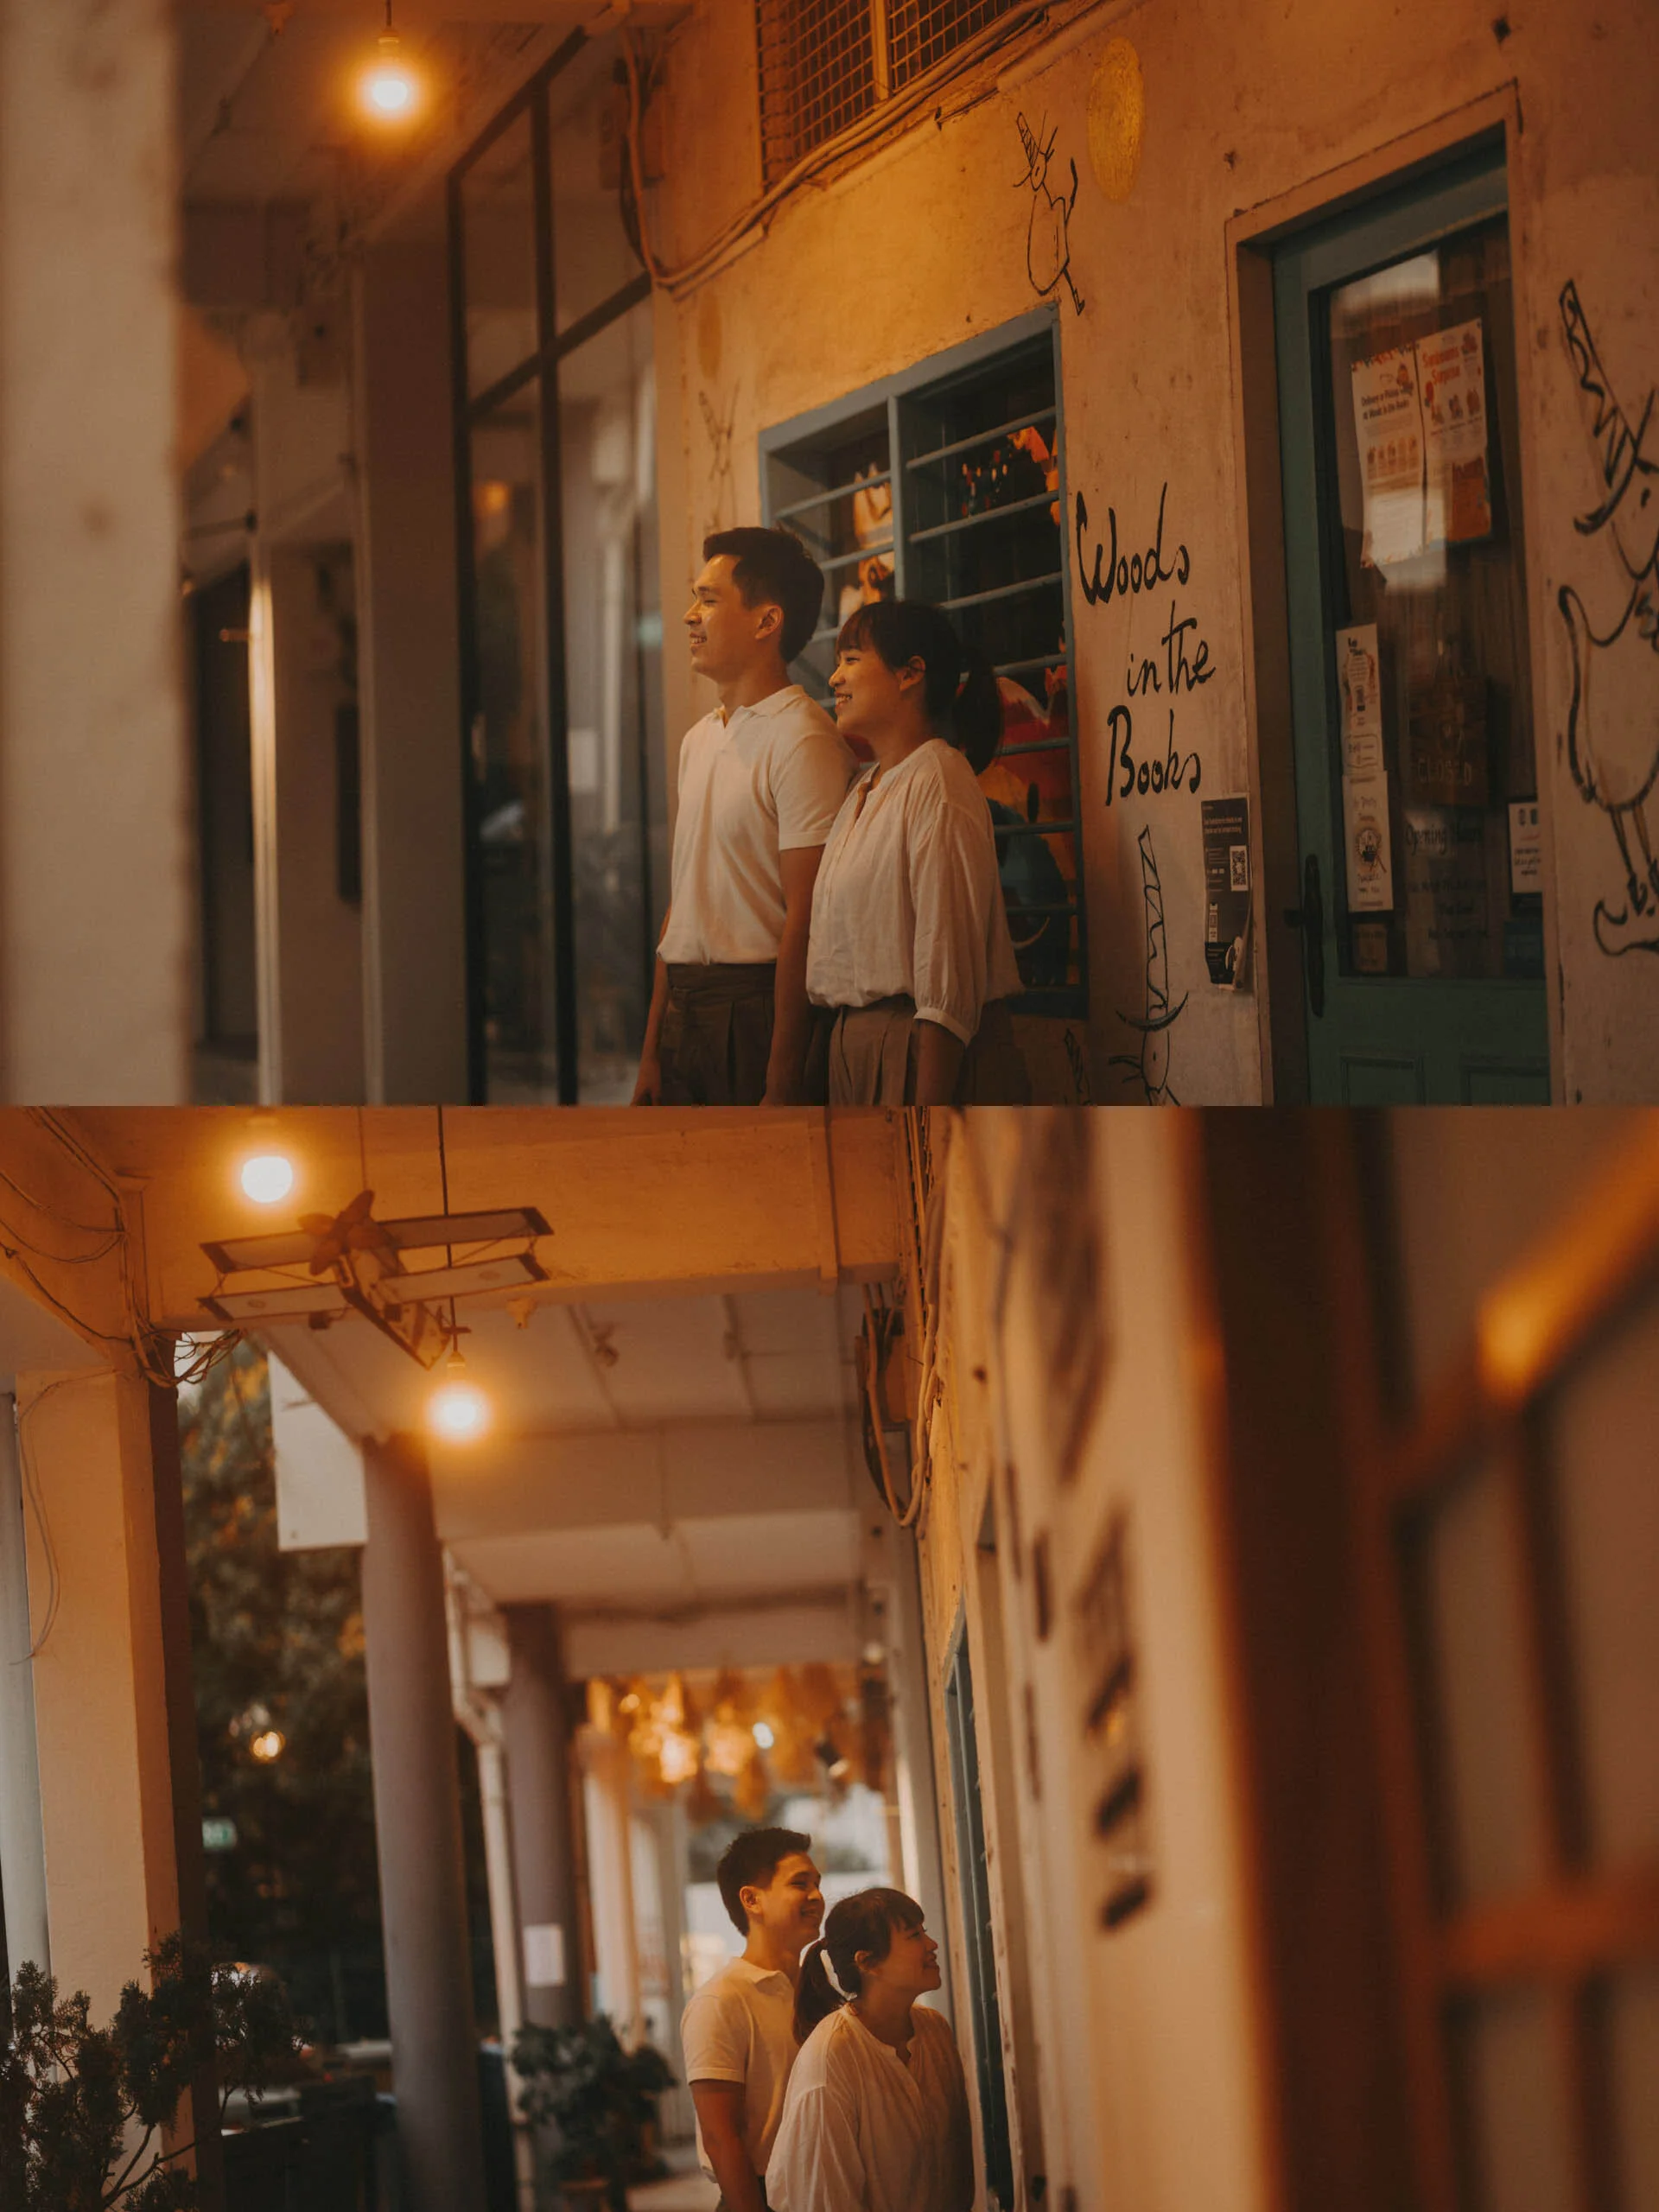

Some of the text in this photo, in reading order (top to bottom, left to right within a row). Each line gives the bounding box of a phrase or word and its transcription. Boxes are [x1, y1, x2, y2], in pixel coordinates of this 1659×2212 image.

[1076, 482, 1191, 606] Woods
[1126, 599, 1217, 697] in the
[1105, 704, 1202, 806] Books
